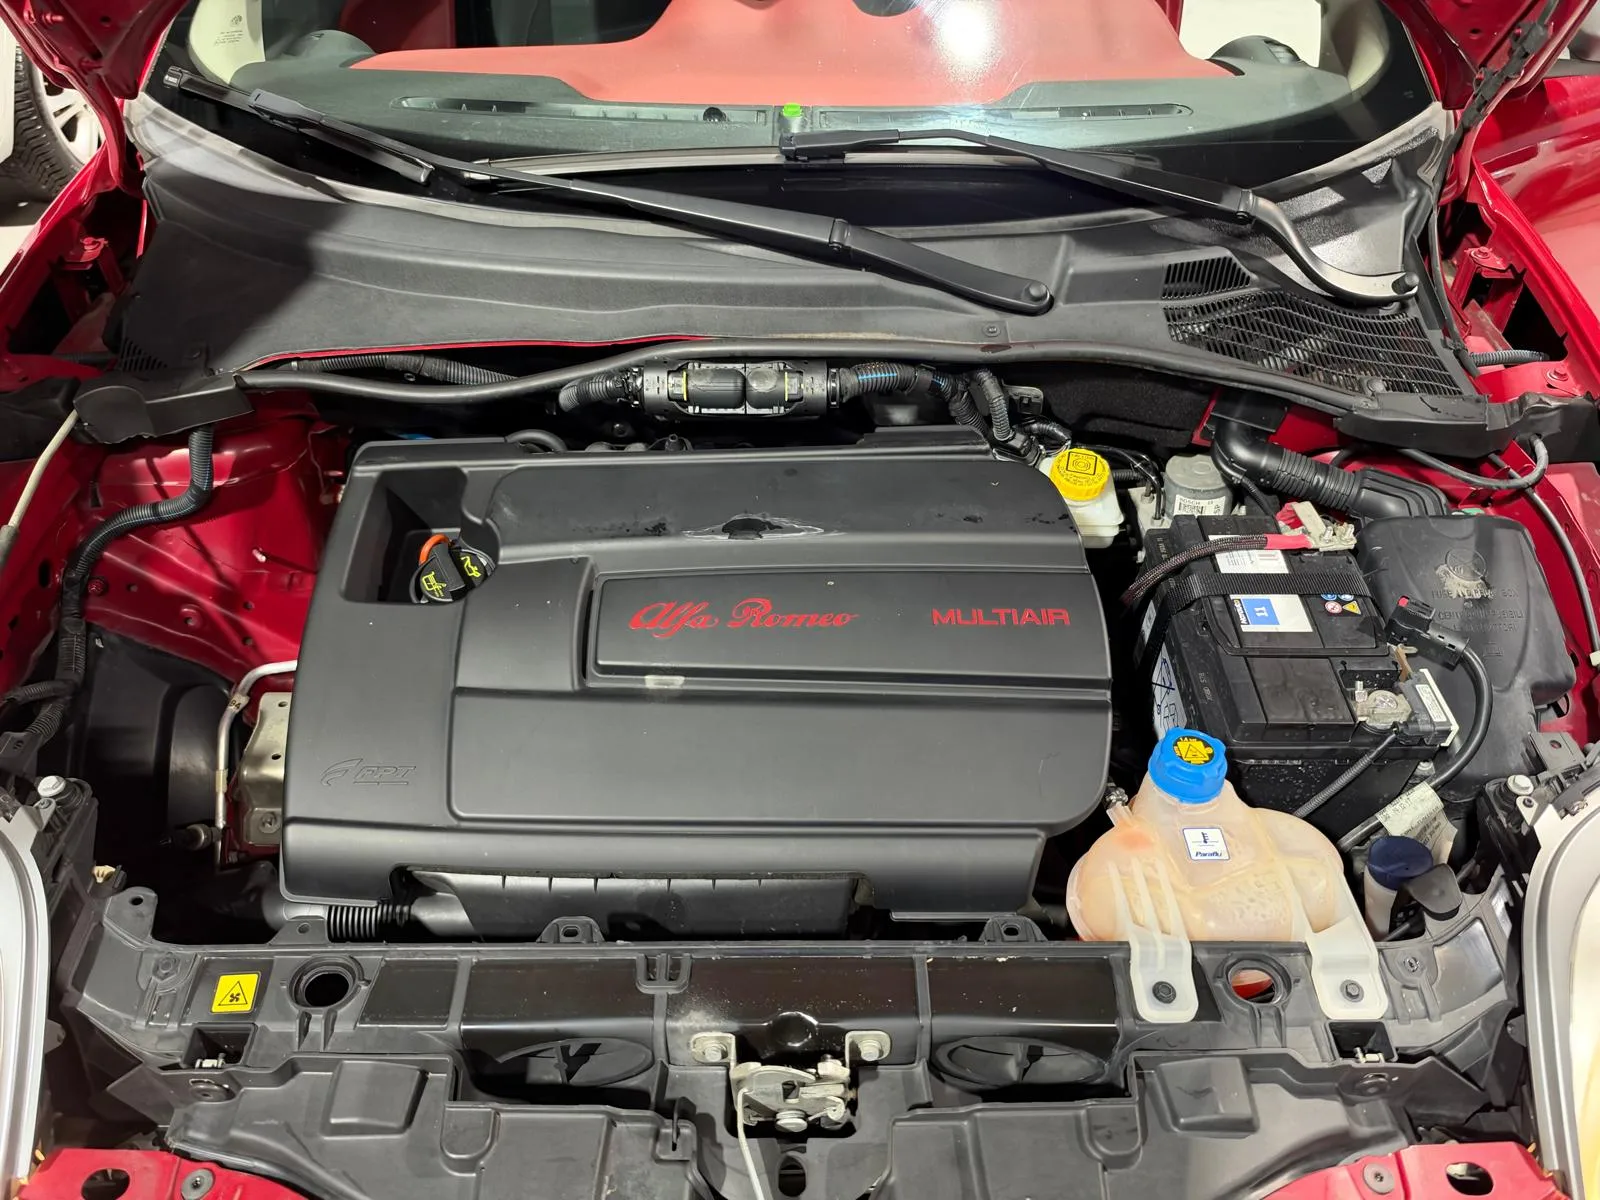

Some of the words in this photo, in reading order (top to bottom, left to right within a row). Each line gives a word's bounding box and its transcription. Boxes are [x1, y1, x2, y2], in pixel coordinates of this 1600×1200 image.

[628, 600, 720, 638] Alfa
[727, 597, 860, 628] Romeo
[931, 607, 1071, 626] MULTIAIR
[1254, 606, 1269, 617] 11
[354, 765, 416, 779] FPT
